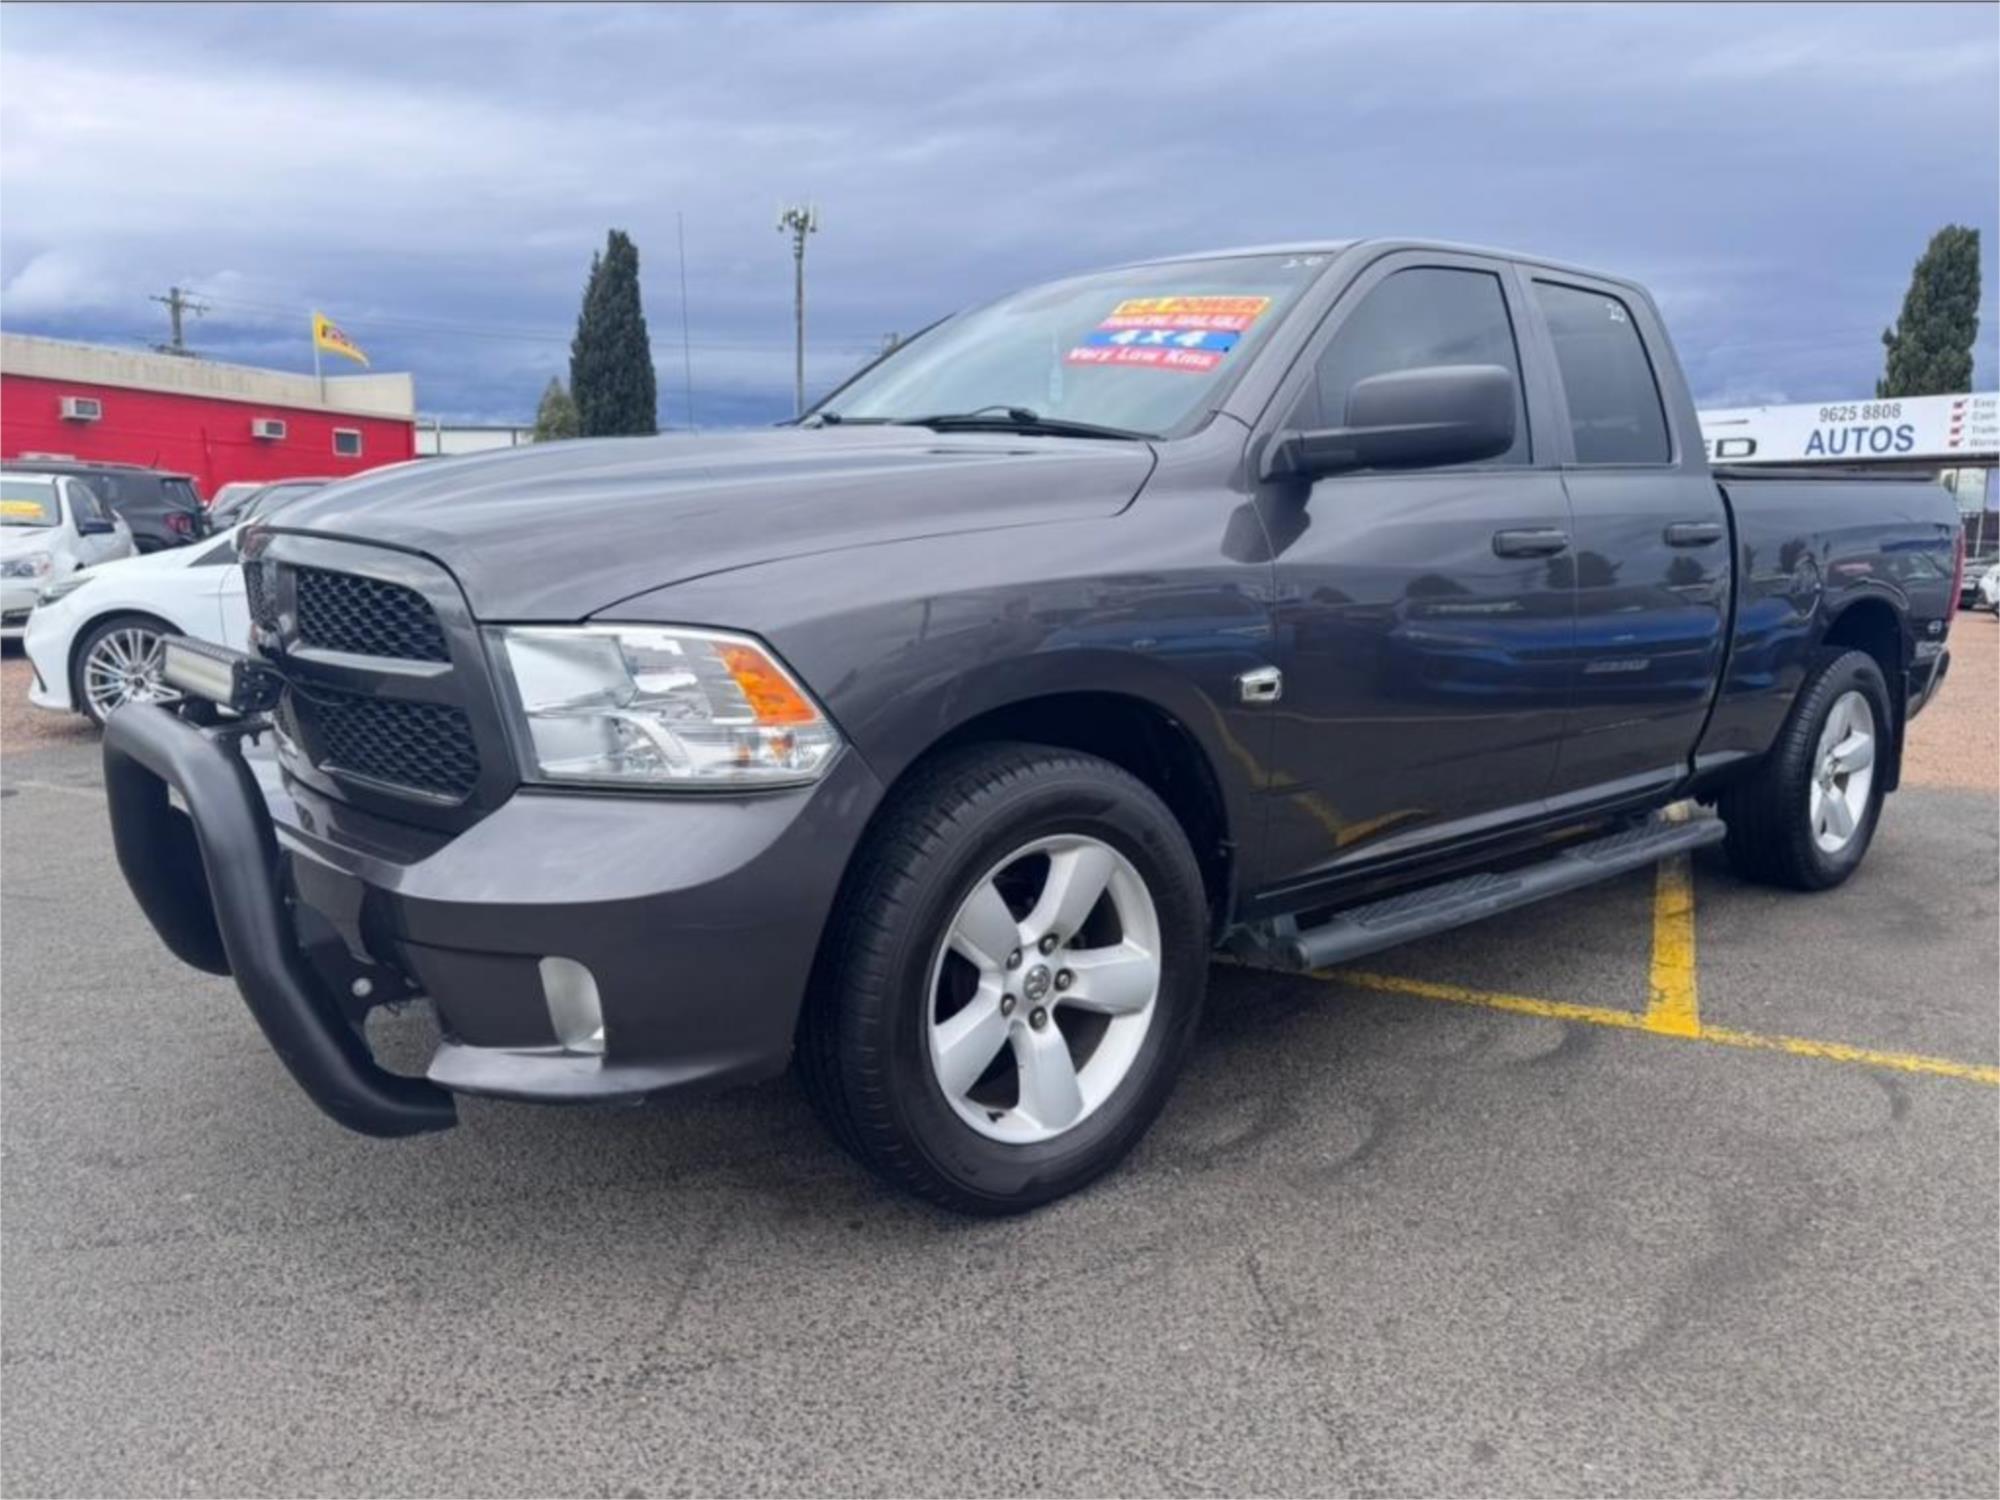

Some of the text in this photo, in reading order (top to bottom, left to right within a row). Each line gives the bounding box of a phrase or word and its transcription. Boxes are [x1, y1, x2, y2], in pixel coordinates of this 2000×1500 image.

[1069, 347, 1111, 361] Very
[1117, 347, 1157, 362] Low
[1819, 403, 1902, 422] 9625 8808
[1804, 424, 1914, 456] AUTOS
